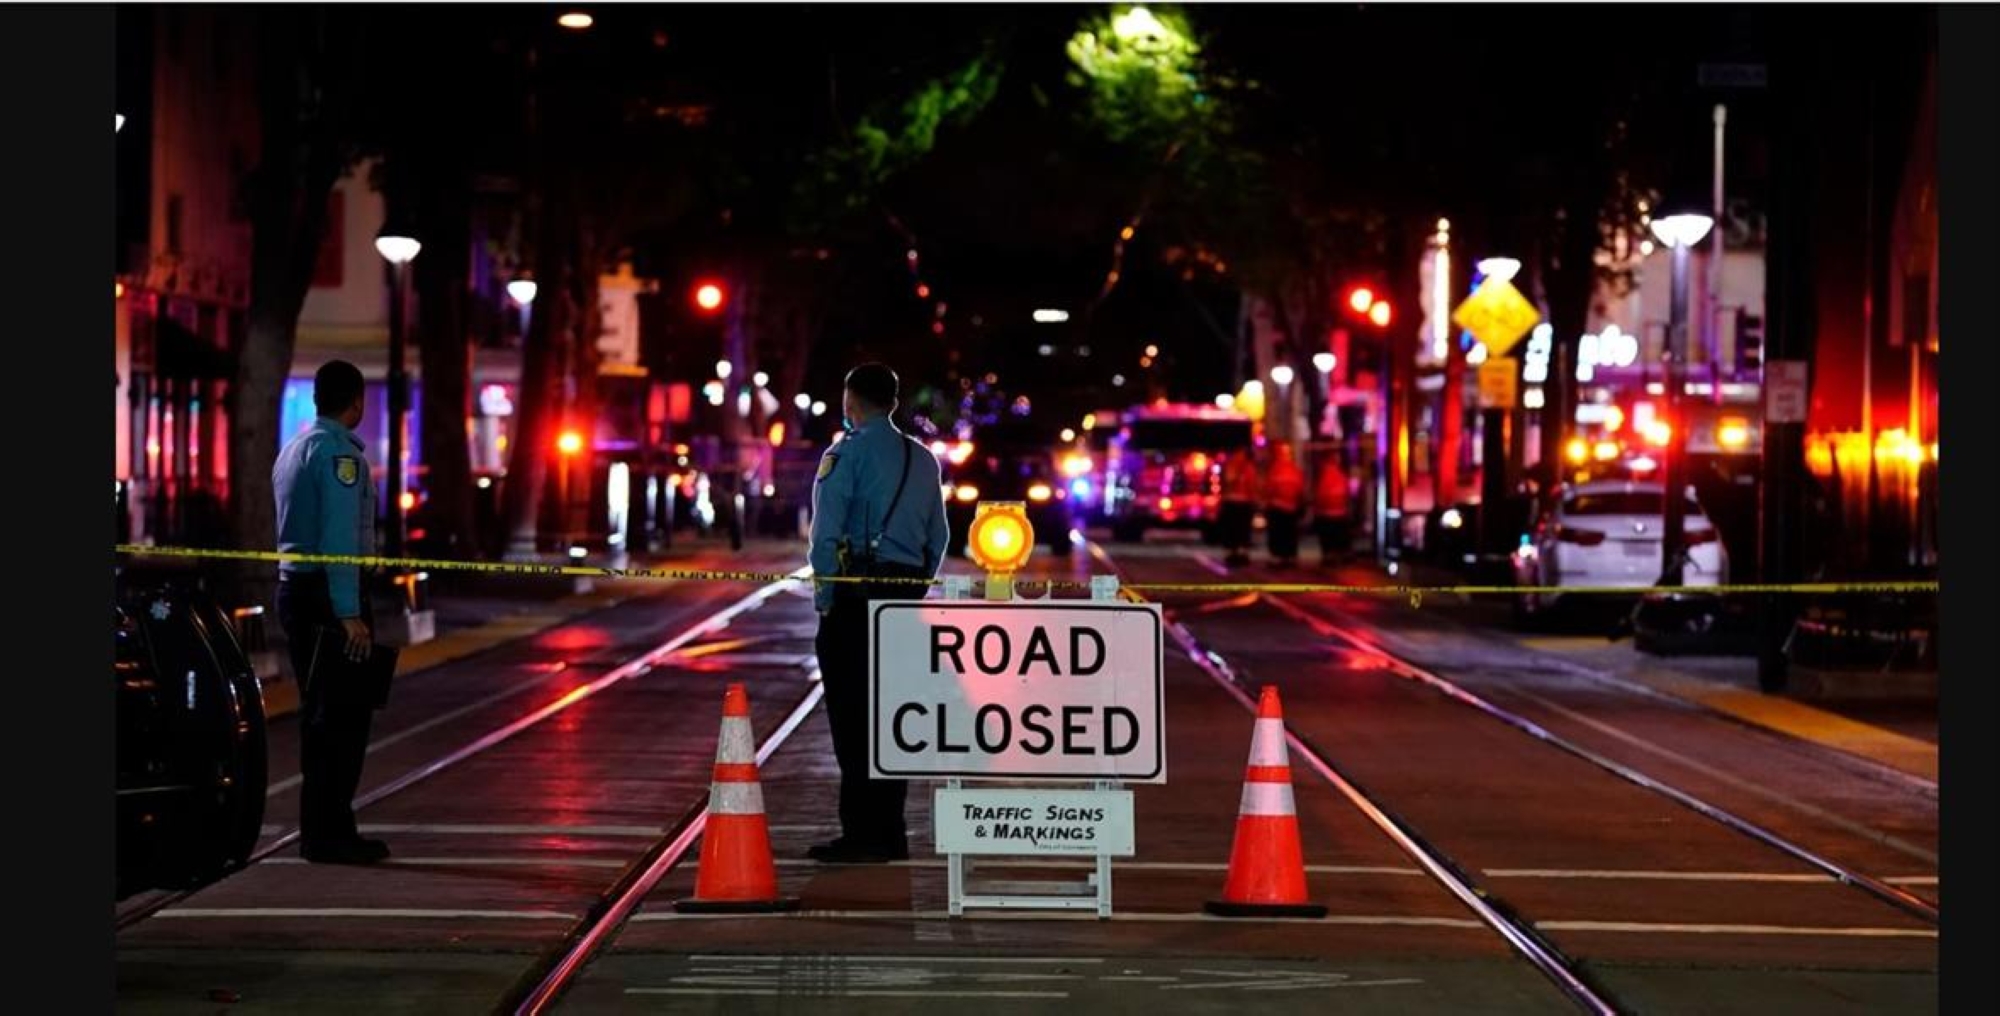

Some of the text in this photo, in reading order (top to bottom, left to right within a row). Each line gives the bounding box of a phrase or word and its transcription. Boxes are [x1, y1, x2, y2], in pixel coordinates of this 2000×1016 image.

[930, 624, 1106, 676] ROAD
[892, 702, 1140, 756] CLOSED
[963, 804, 1105, 821] TRAFFIC SIGNS
[974, 824, 1095, 846] & MARKINGS
